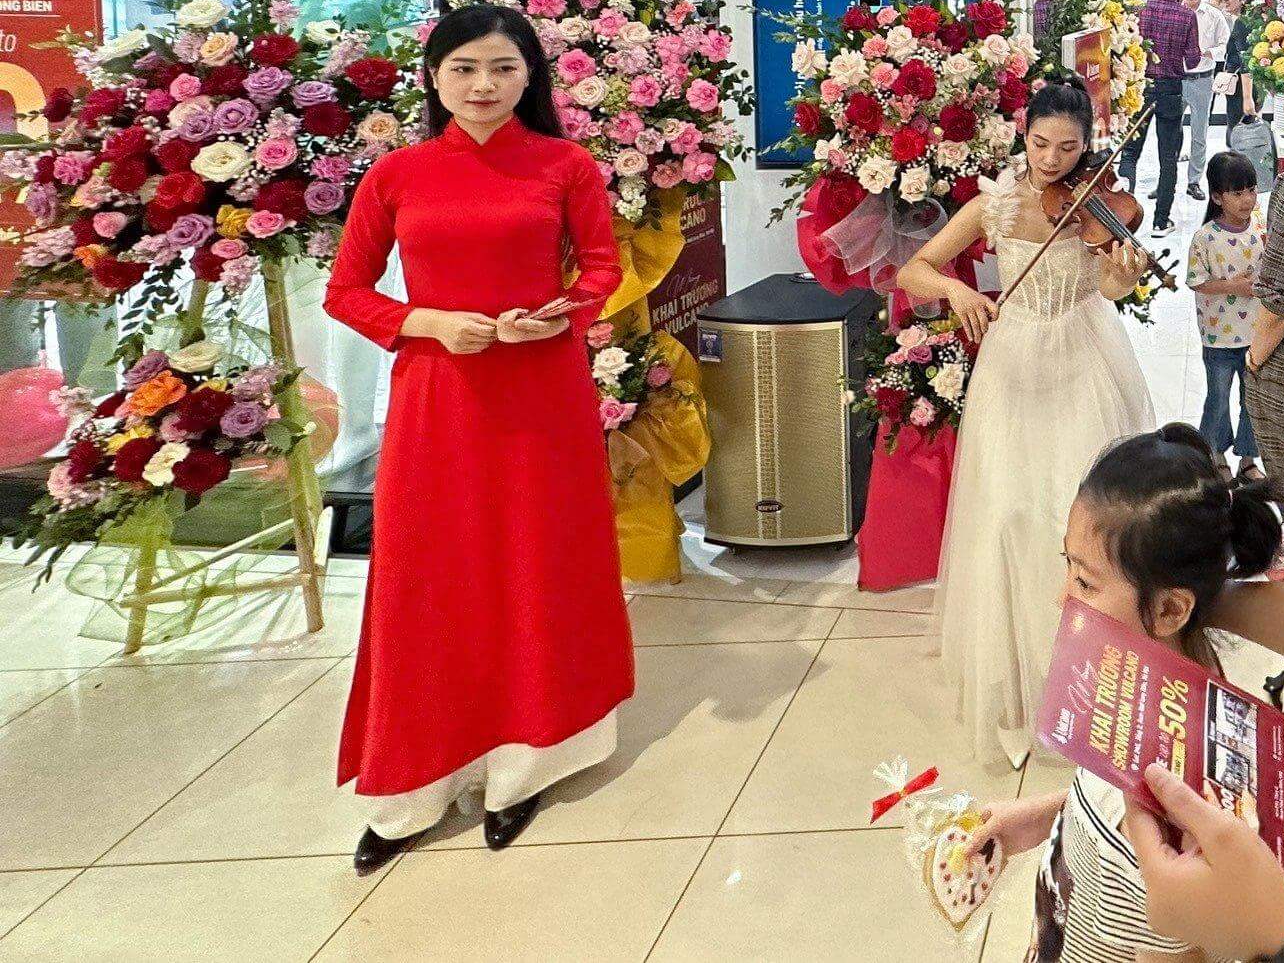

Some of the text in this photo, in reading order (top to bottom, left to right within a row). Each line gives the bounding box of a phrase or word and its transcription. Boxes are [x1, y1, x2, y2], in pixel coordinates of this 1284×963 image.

[652, 298, 679, 324] KHAI
[1087, 707, 1114, 754] KHAI
[1111, 649, 1140, 771] SHOWROOM VULCANO
[1158, 675, 1190, 740] 50%
